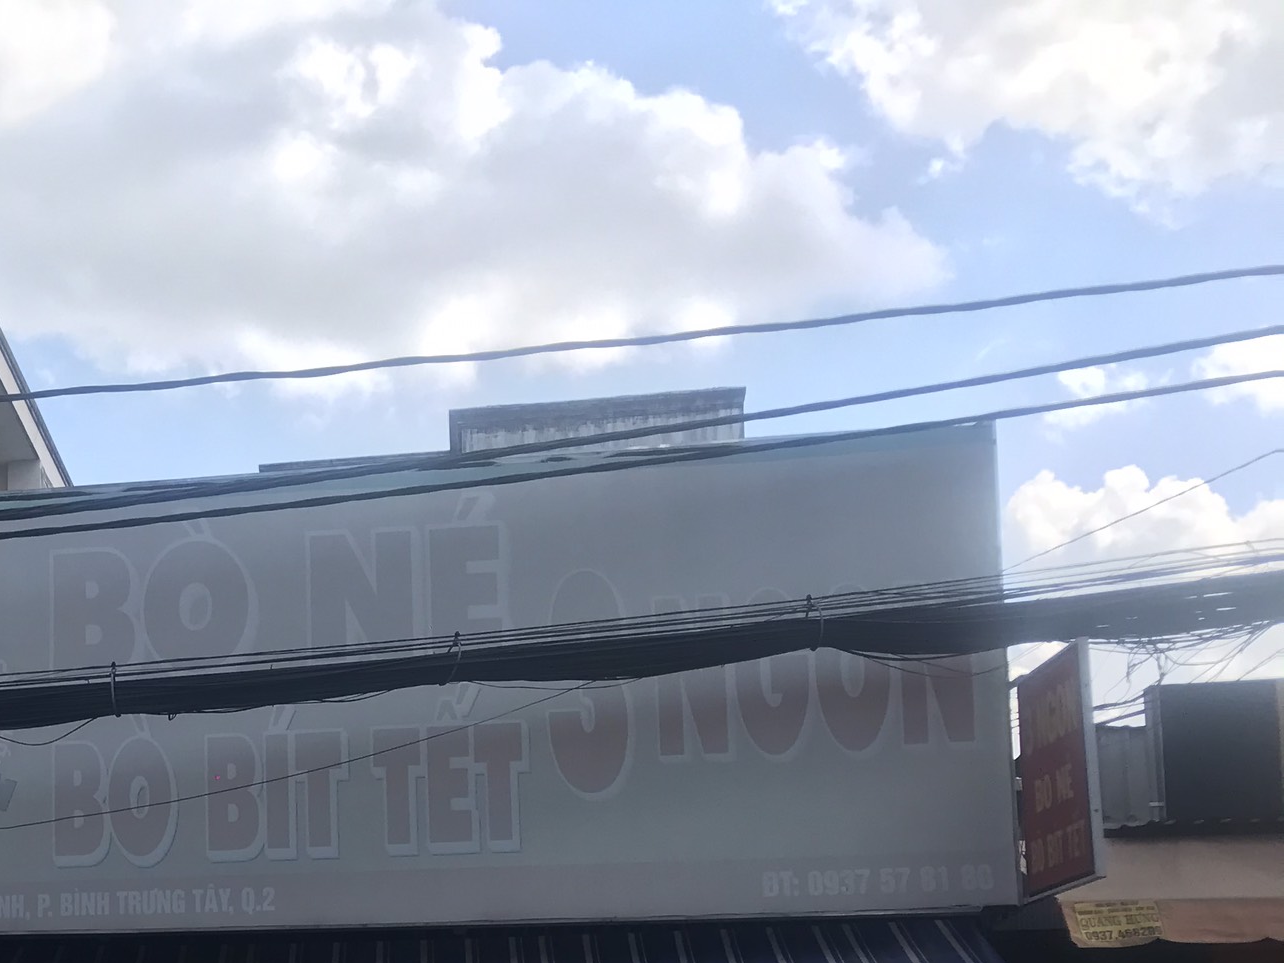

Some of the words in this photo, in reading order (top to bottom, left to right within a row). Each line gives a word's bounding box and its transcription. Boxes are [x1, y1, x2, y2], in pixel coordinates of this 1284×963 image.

[49, 517, 260, 682] BÒ
[305, 494, 516, 656] NÉ
[53, 714, 180, 868] BÒ
[204, 704, 351, 863] BÍT
[371, 685, 531, 858] TẾT
[36, 893, 53, 919] P.
[59, 887, 111, 918] BÌNH
[116, 887, 187, 915] TRƯNG
[192, 883, 234, 915] TÂY,
[241, 886, 276, 914] Q.2
[807, 868, 871, 897] 0937
[879, 866, 911, 894] 57
